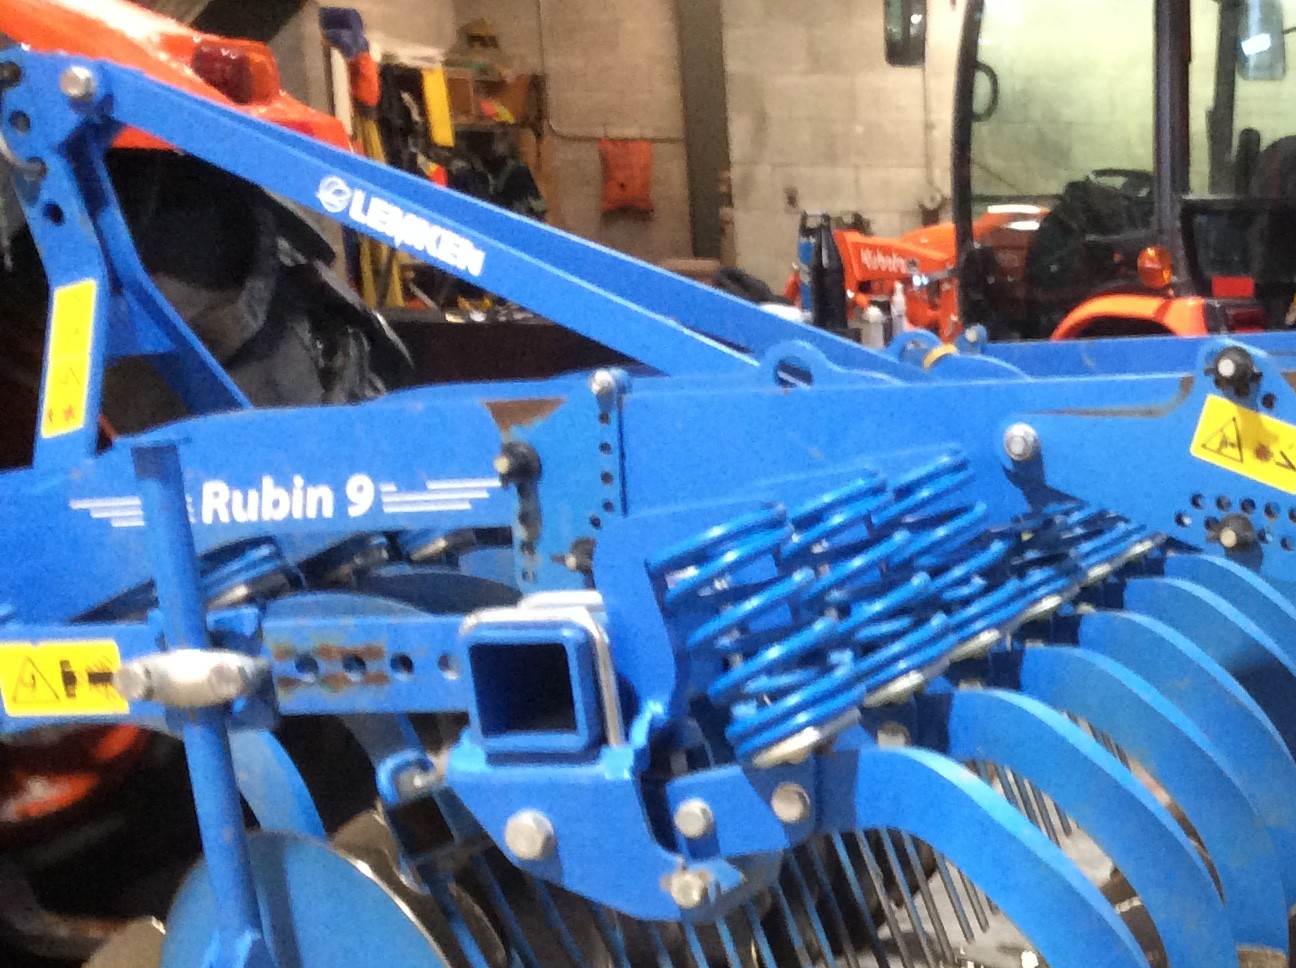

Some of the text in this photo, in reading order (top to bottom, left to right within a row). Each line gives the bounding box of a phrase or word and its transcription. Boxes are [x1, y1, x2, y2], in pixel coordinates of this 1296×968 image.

[349, 188, 486, 278] LEMKEN
[202, 472, 375, 525] Rubin 9
